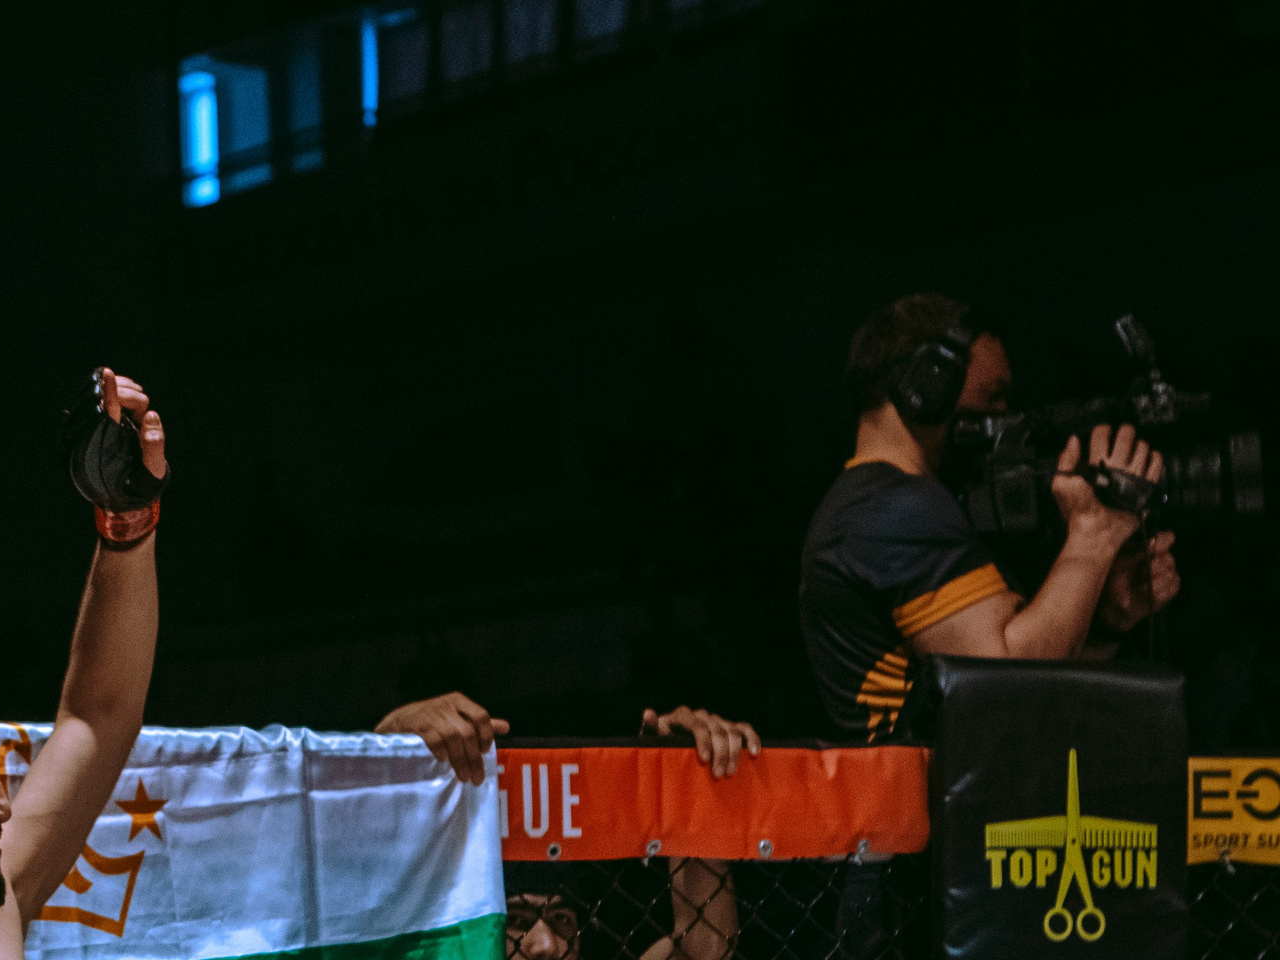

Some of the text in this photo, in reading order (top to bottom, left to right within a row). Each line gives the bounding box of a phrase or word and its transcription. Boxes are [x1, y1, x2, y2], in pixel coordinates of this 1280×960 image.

[1193, 832, 1249, 850] SPORT
[985, 849, 1158, 889] TOP GUN
